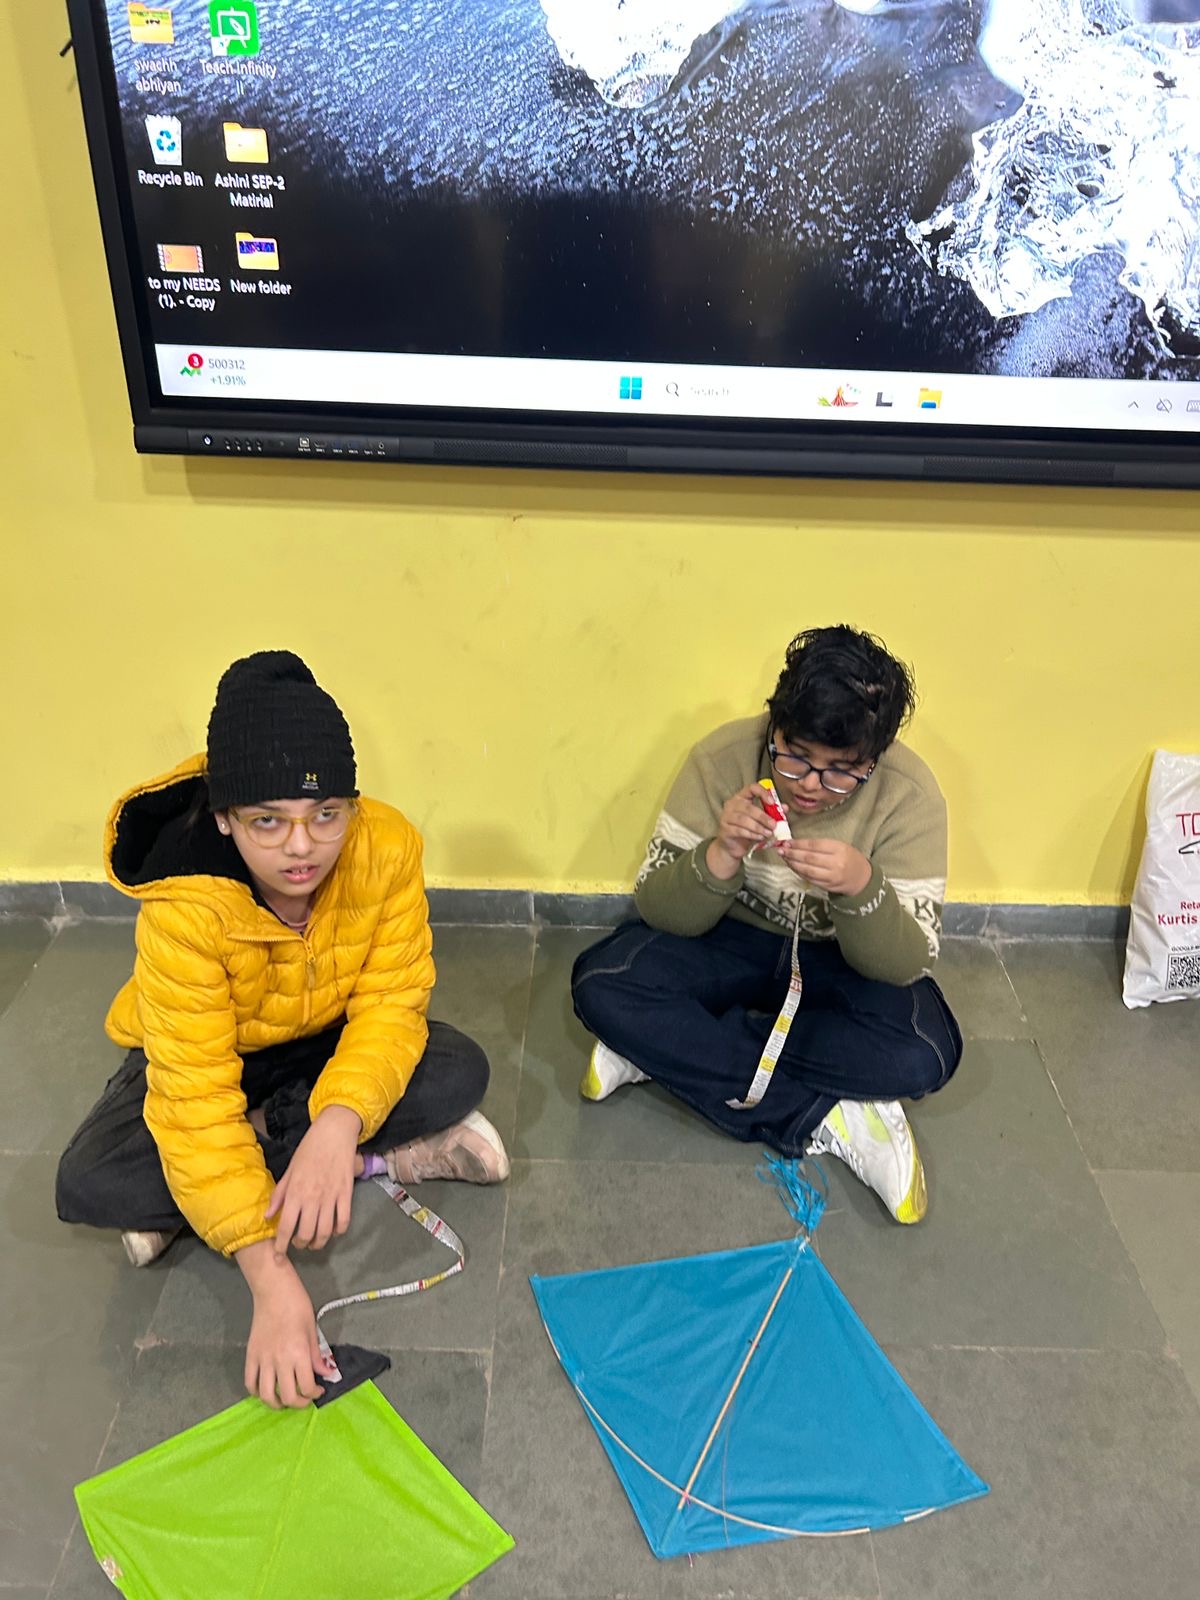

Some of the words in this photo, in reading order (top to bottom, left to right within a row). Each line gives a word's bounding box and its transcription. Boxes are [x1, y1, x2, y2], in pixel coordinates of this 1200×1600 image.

[134, 57, 178, 73] swachh
[200, 58, 234, 75] Teach
[237, 60, 277, 80] Infinity
[136, 78, 181, 95] abhiyan
[138, 170, 182, 187] Recycle
[184, 172, 204, 187] Bin
[214, 173, 250, 189] Ashini
[252, 175, 286, 191] SEP-2
[229, 192, 274, 209] Matirial
[148, 277, 161, 290] to
[163, 280, 181, 293] my
[183, 278, 221, 292] NEEDS
[230, 279, 256, 294] New
[259, 280, 292, 295] folder
[186, 296, 216, 311] Copy
[208, 357, 246, 371] 500312
[210, 375, 247, 387] +1.91%
[1158, 913, 1198, 925] Kurtis
